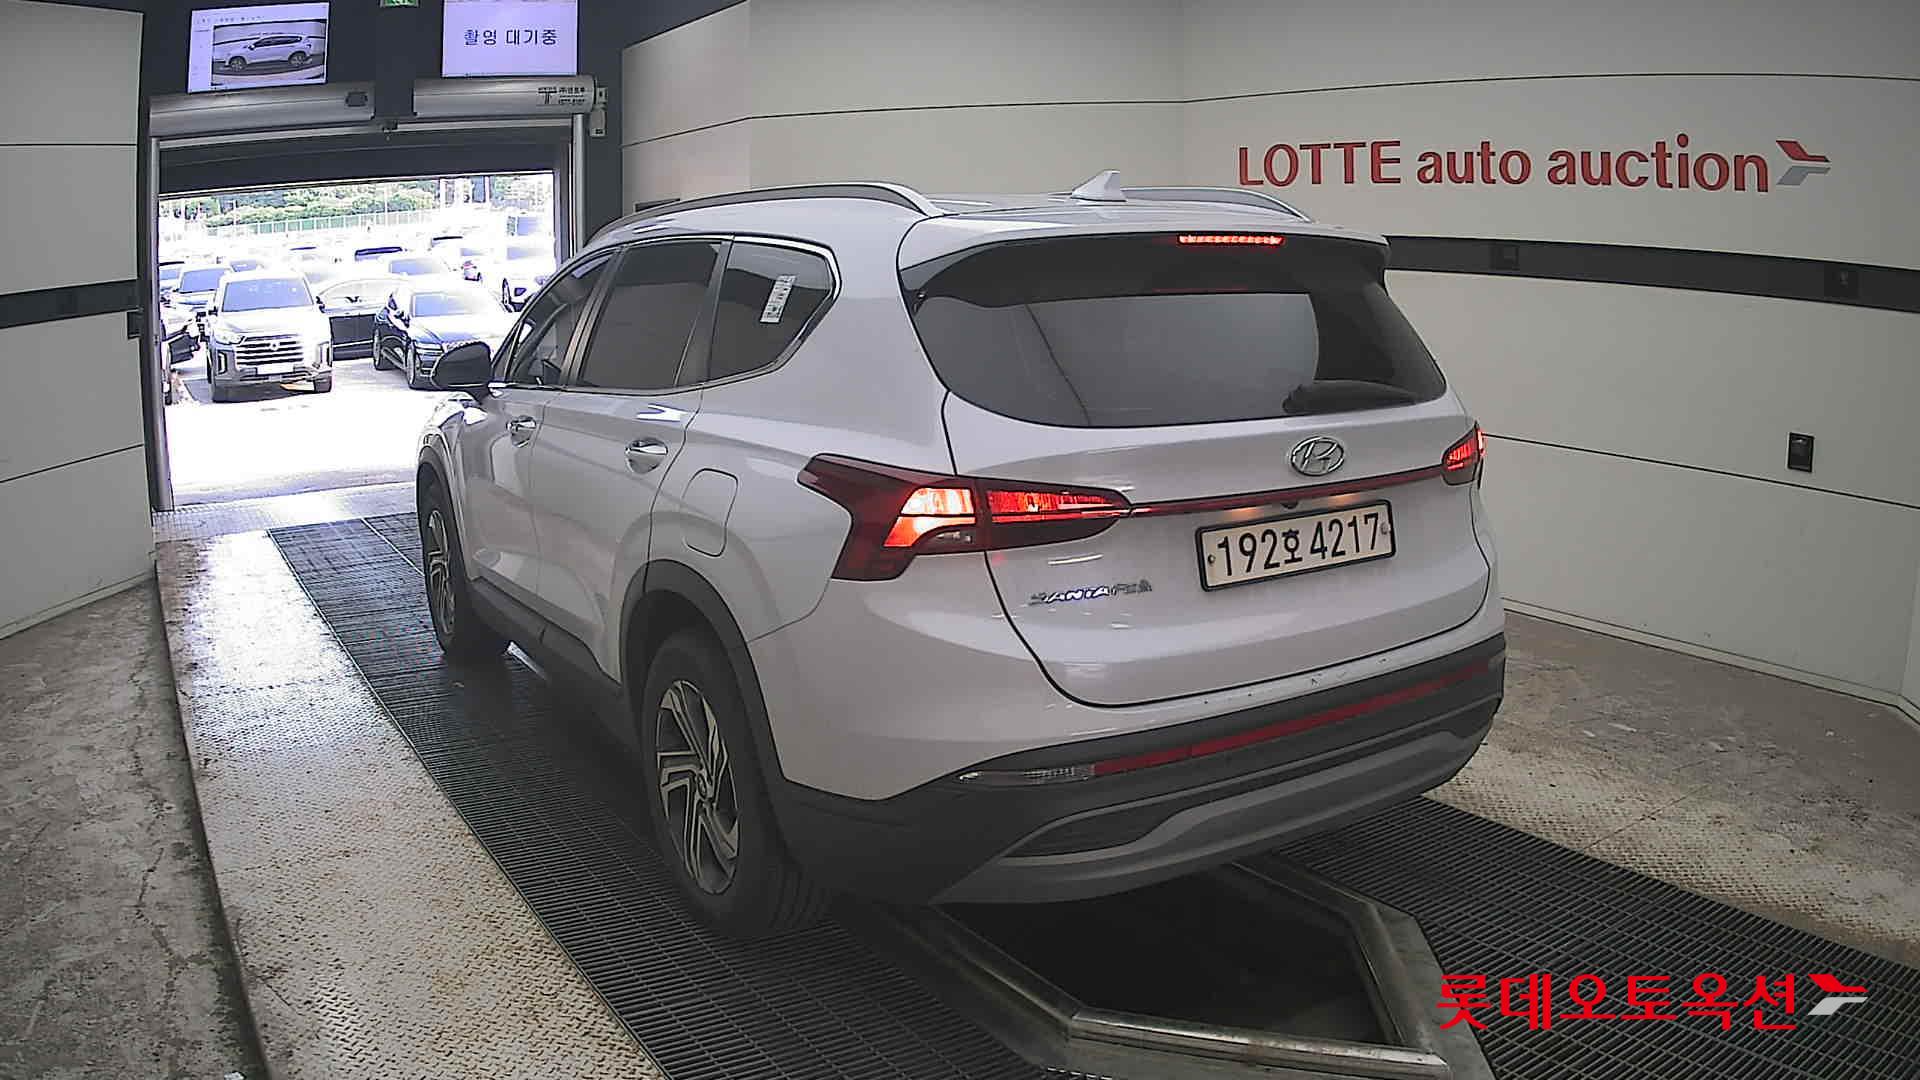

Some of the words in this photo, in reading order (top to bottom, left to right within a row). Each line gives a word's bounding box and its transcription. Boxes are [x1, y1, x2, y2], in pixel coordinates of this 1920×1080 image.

[464, 29, 497, 46] 촬영
[505, 29, 557, 46] 대기중
[1238, 140, 1401, 186] LOTTE
[1417, 140, 1532, 185] auto
[1547, 133, 1769, 193] auction
[1217, 528, 1304, 577] 192호
[1309, 512, 1379, 560] 4217
